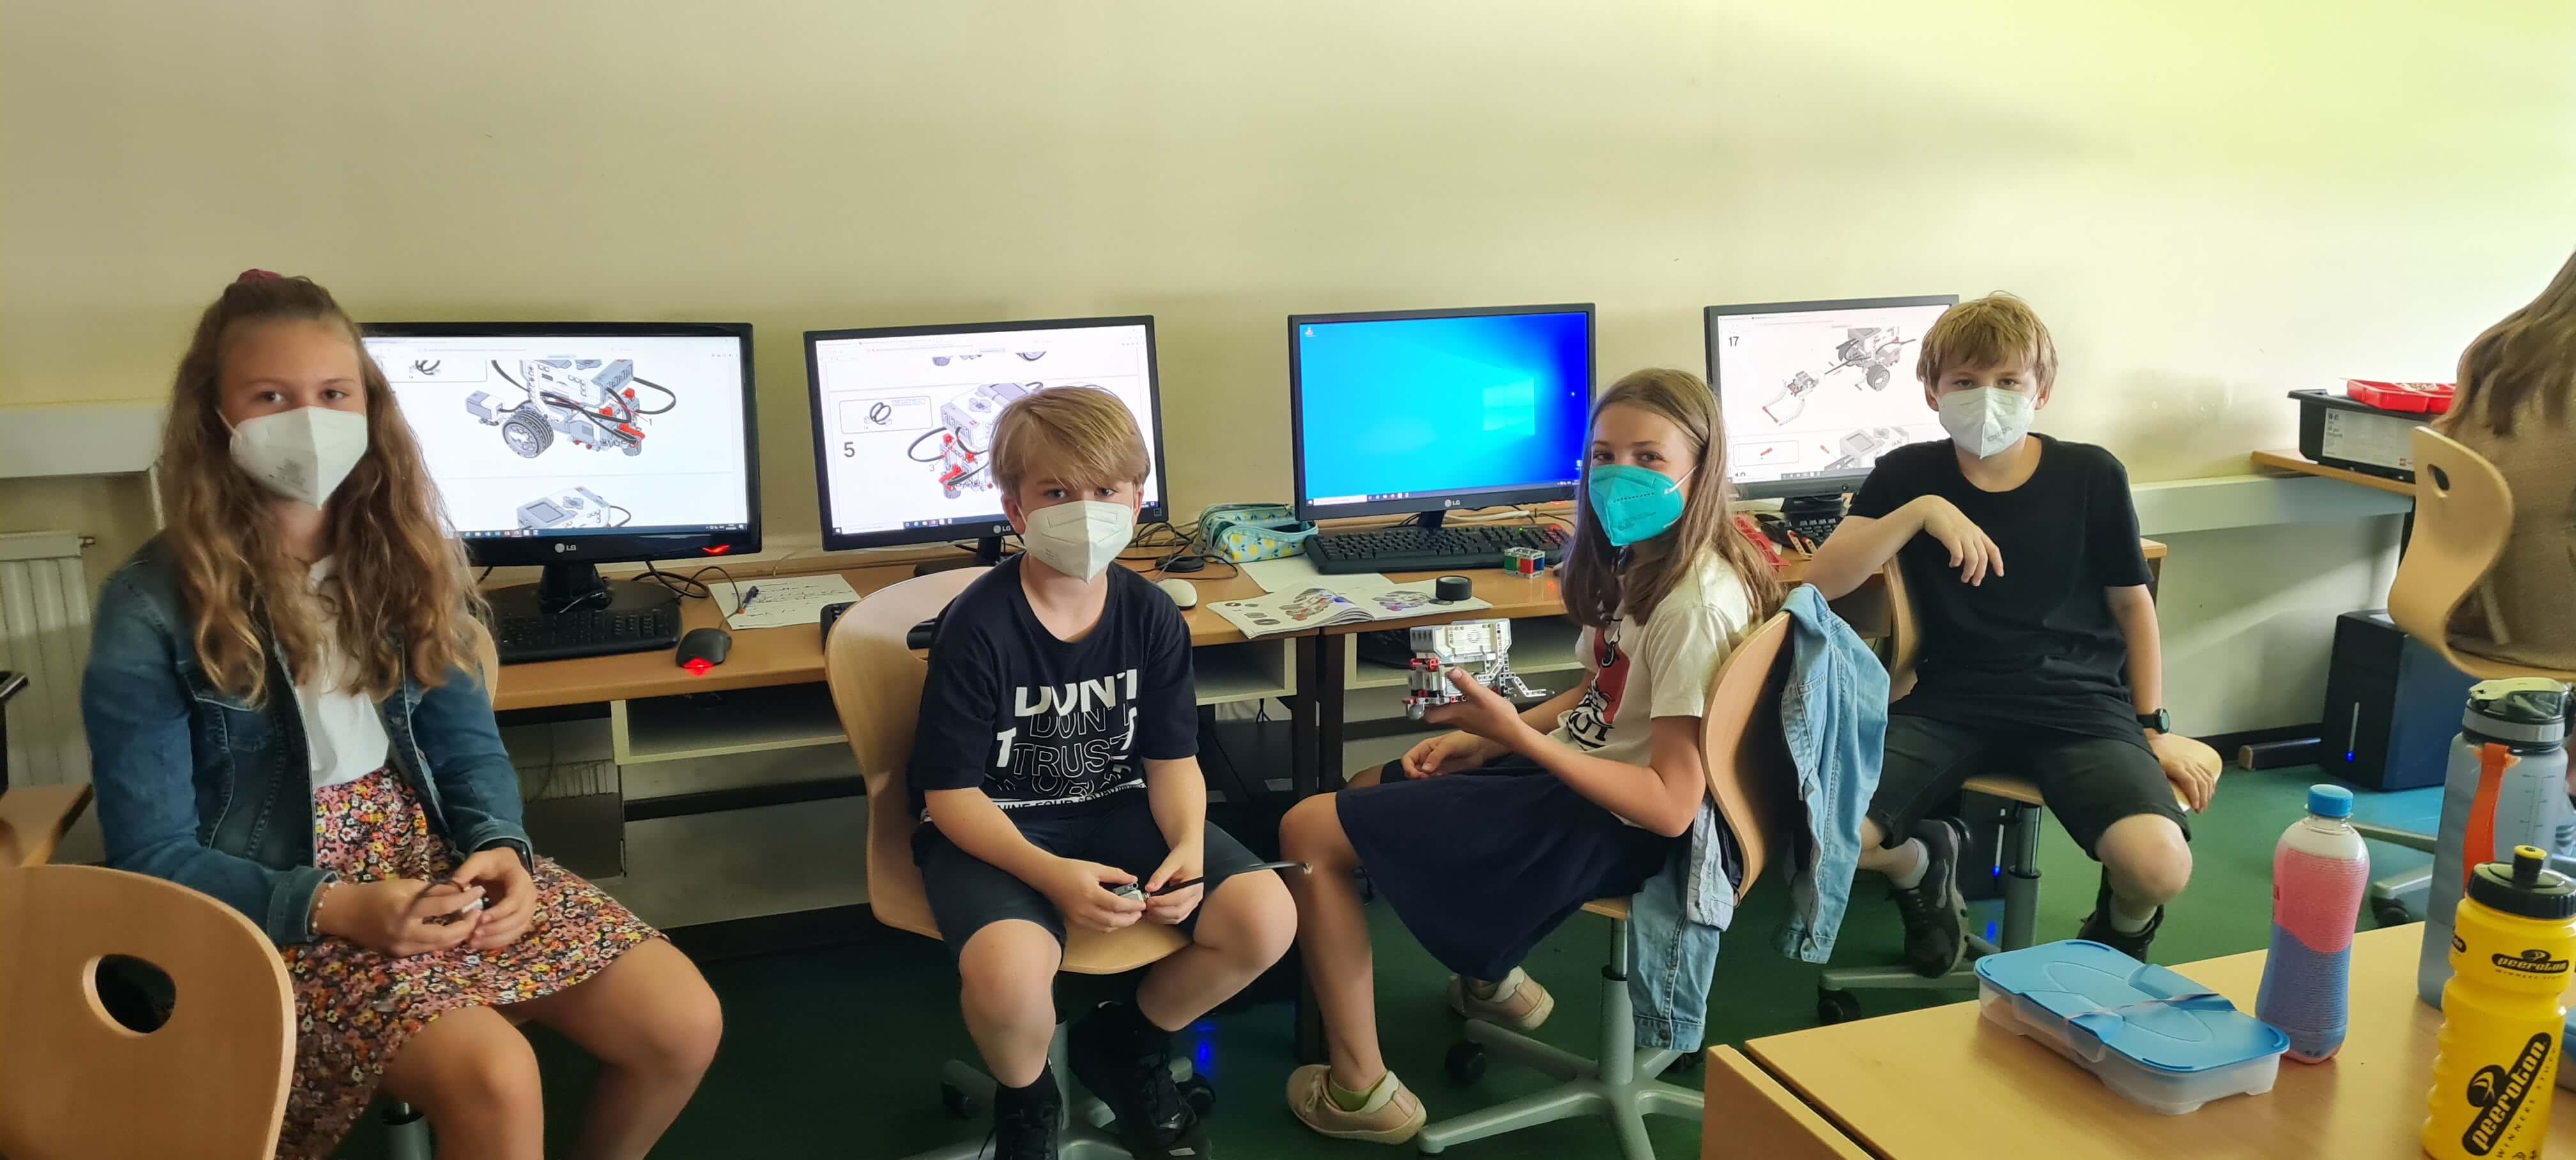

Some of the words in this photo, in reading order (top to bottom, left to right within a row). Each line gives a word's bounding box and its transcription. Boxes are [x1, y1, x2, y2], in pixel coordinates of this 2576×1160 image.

[1729, 336, 1739, 347] 17
[843, 441, 855, 457] 5
[2472, 1041, 2546, 1151] peeroton
[2496, 1099, 2535, 1158] WINNERS
